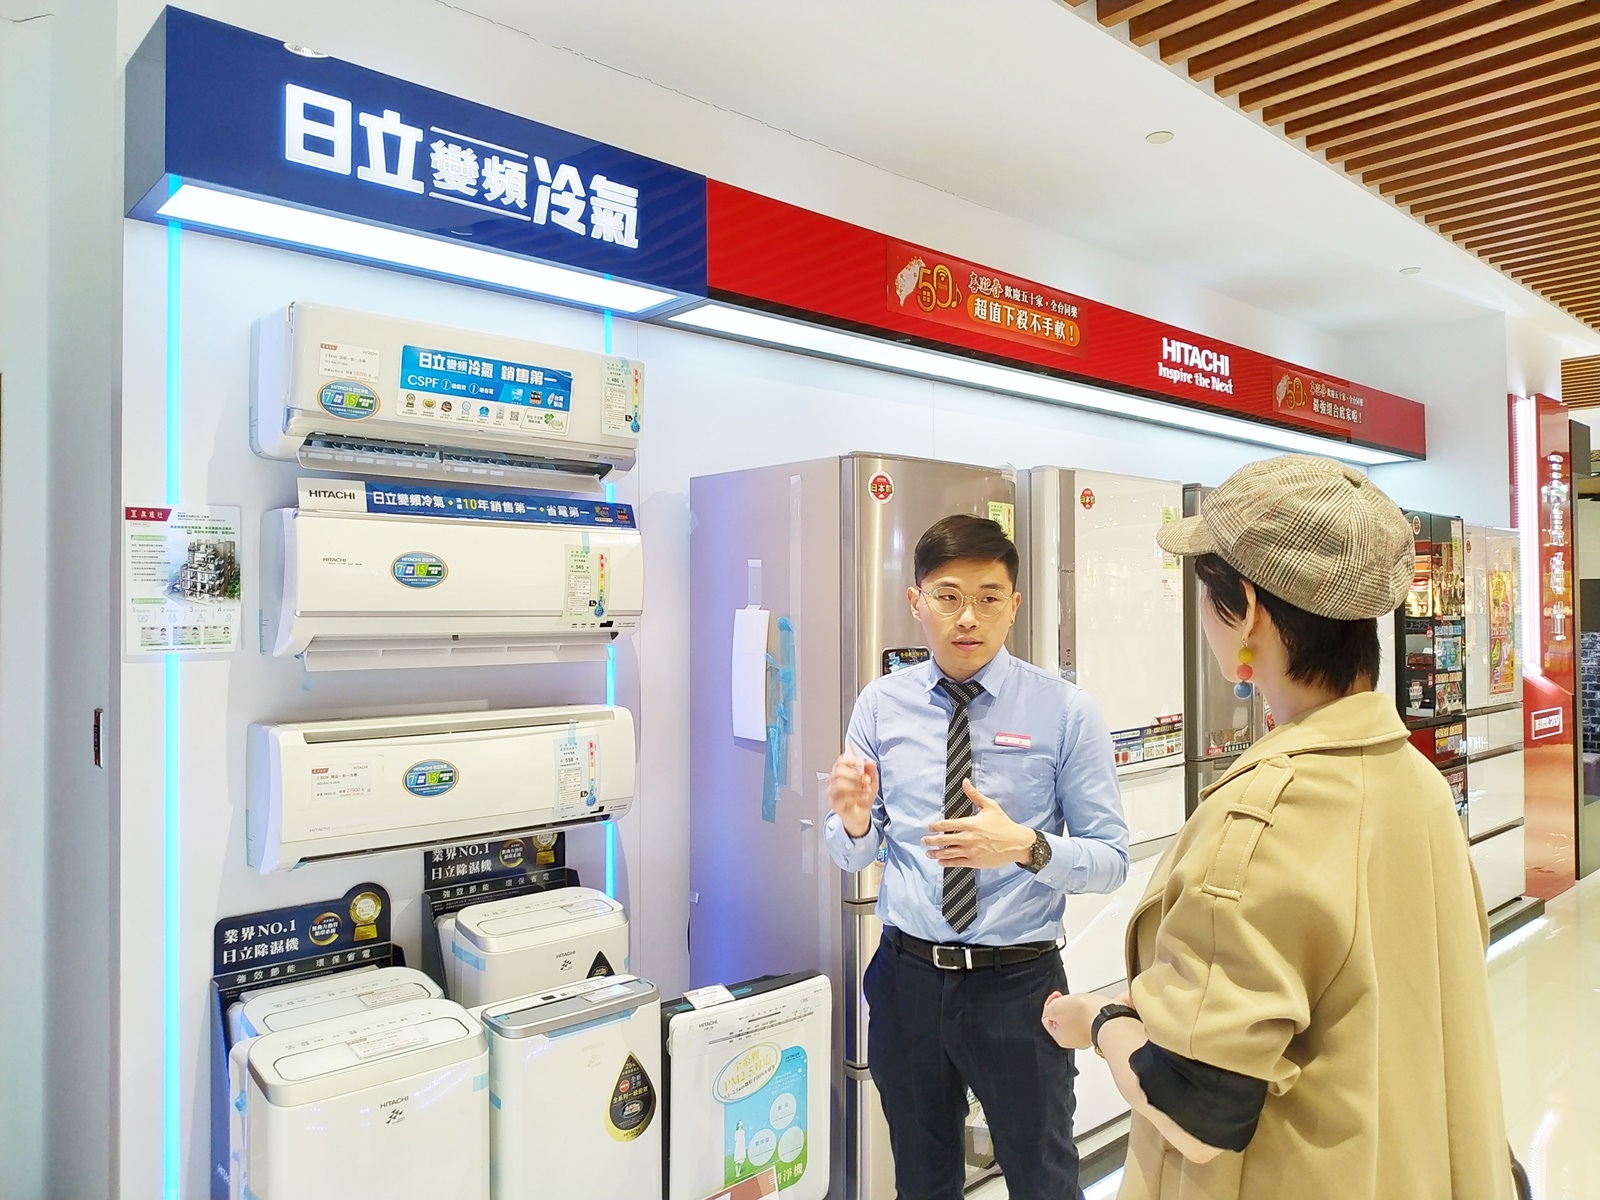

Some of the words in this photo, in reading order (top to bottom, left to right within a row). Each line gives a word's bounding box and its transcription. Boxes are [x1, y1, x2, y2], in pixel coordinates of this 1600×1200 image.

[285, 83, 639, 249] 日立變頻冷氣
[974, 297, 1075, 342] 超值下殺不手軟！
[419, 352, 494, 379] 日立變頻冷氣
[501, 365, 558, 386] 銷售第一
[1161, 337, 1229, 376] HITACHI
[331, 384, 352, 392] HITACHI
[407, 374, 439, 388] CSPF
[1157, 362, 1193, 384] Inspire
[1194, 373, 1210, 388] the
[1211, 376, 1234, 394] Next
[309, 490, 356, 500] HITACHI
[373, 491, 446, 509] 日立變頻冷氣
[546, 505, 590, 518] 省電第一
[431, 859, 493, 881] 日立除濕機
[443, 883, 490, 899] 強效節能
[505, 873, 550, 888] 環保省電
[223, 919, 297, 945] 業界NO.1
[222, 937, 300, 965] 日立除濕機
[556, 950, 576, 959] HITACHI
[236, 964, 296, 985] 強效節能
[316, 949, 372, 968] 環保省電
[380, 1095, 409, 1109] HITACHI
